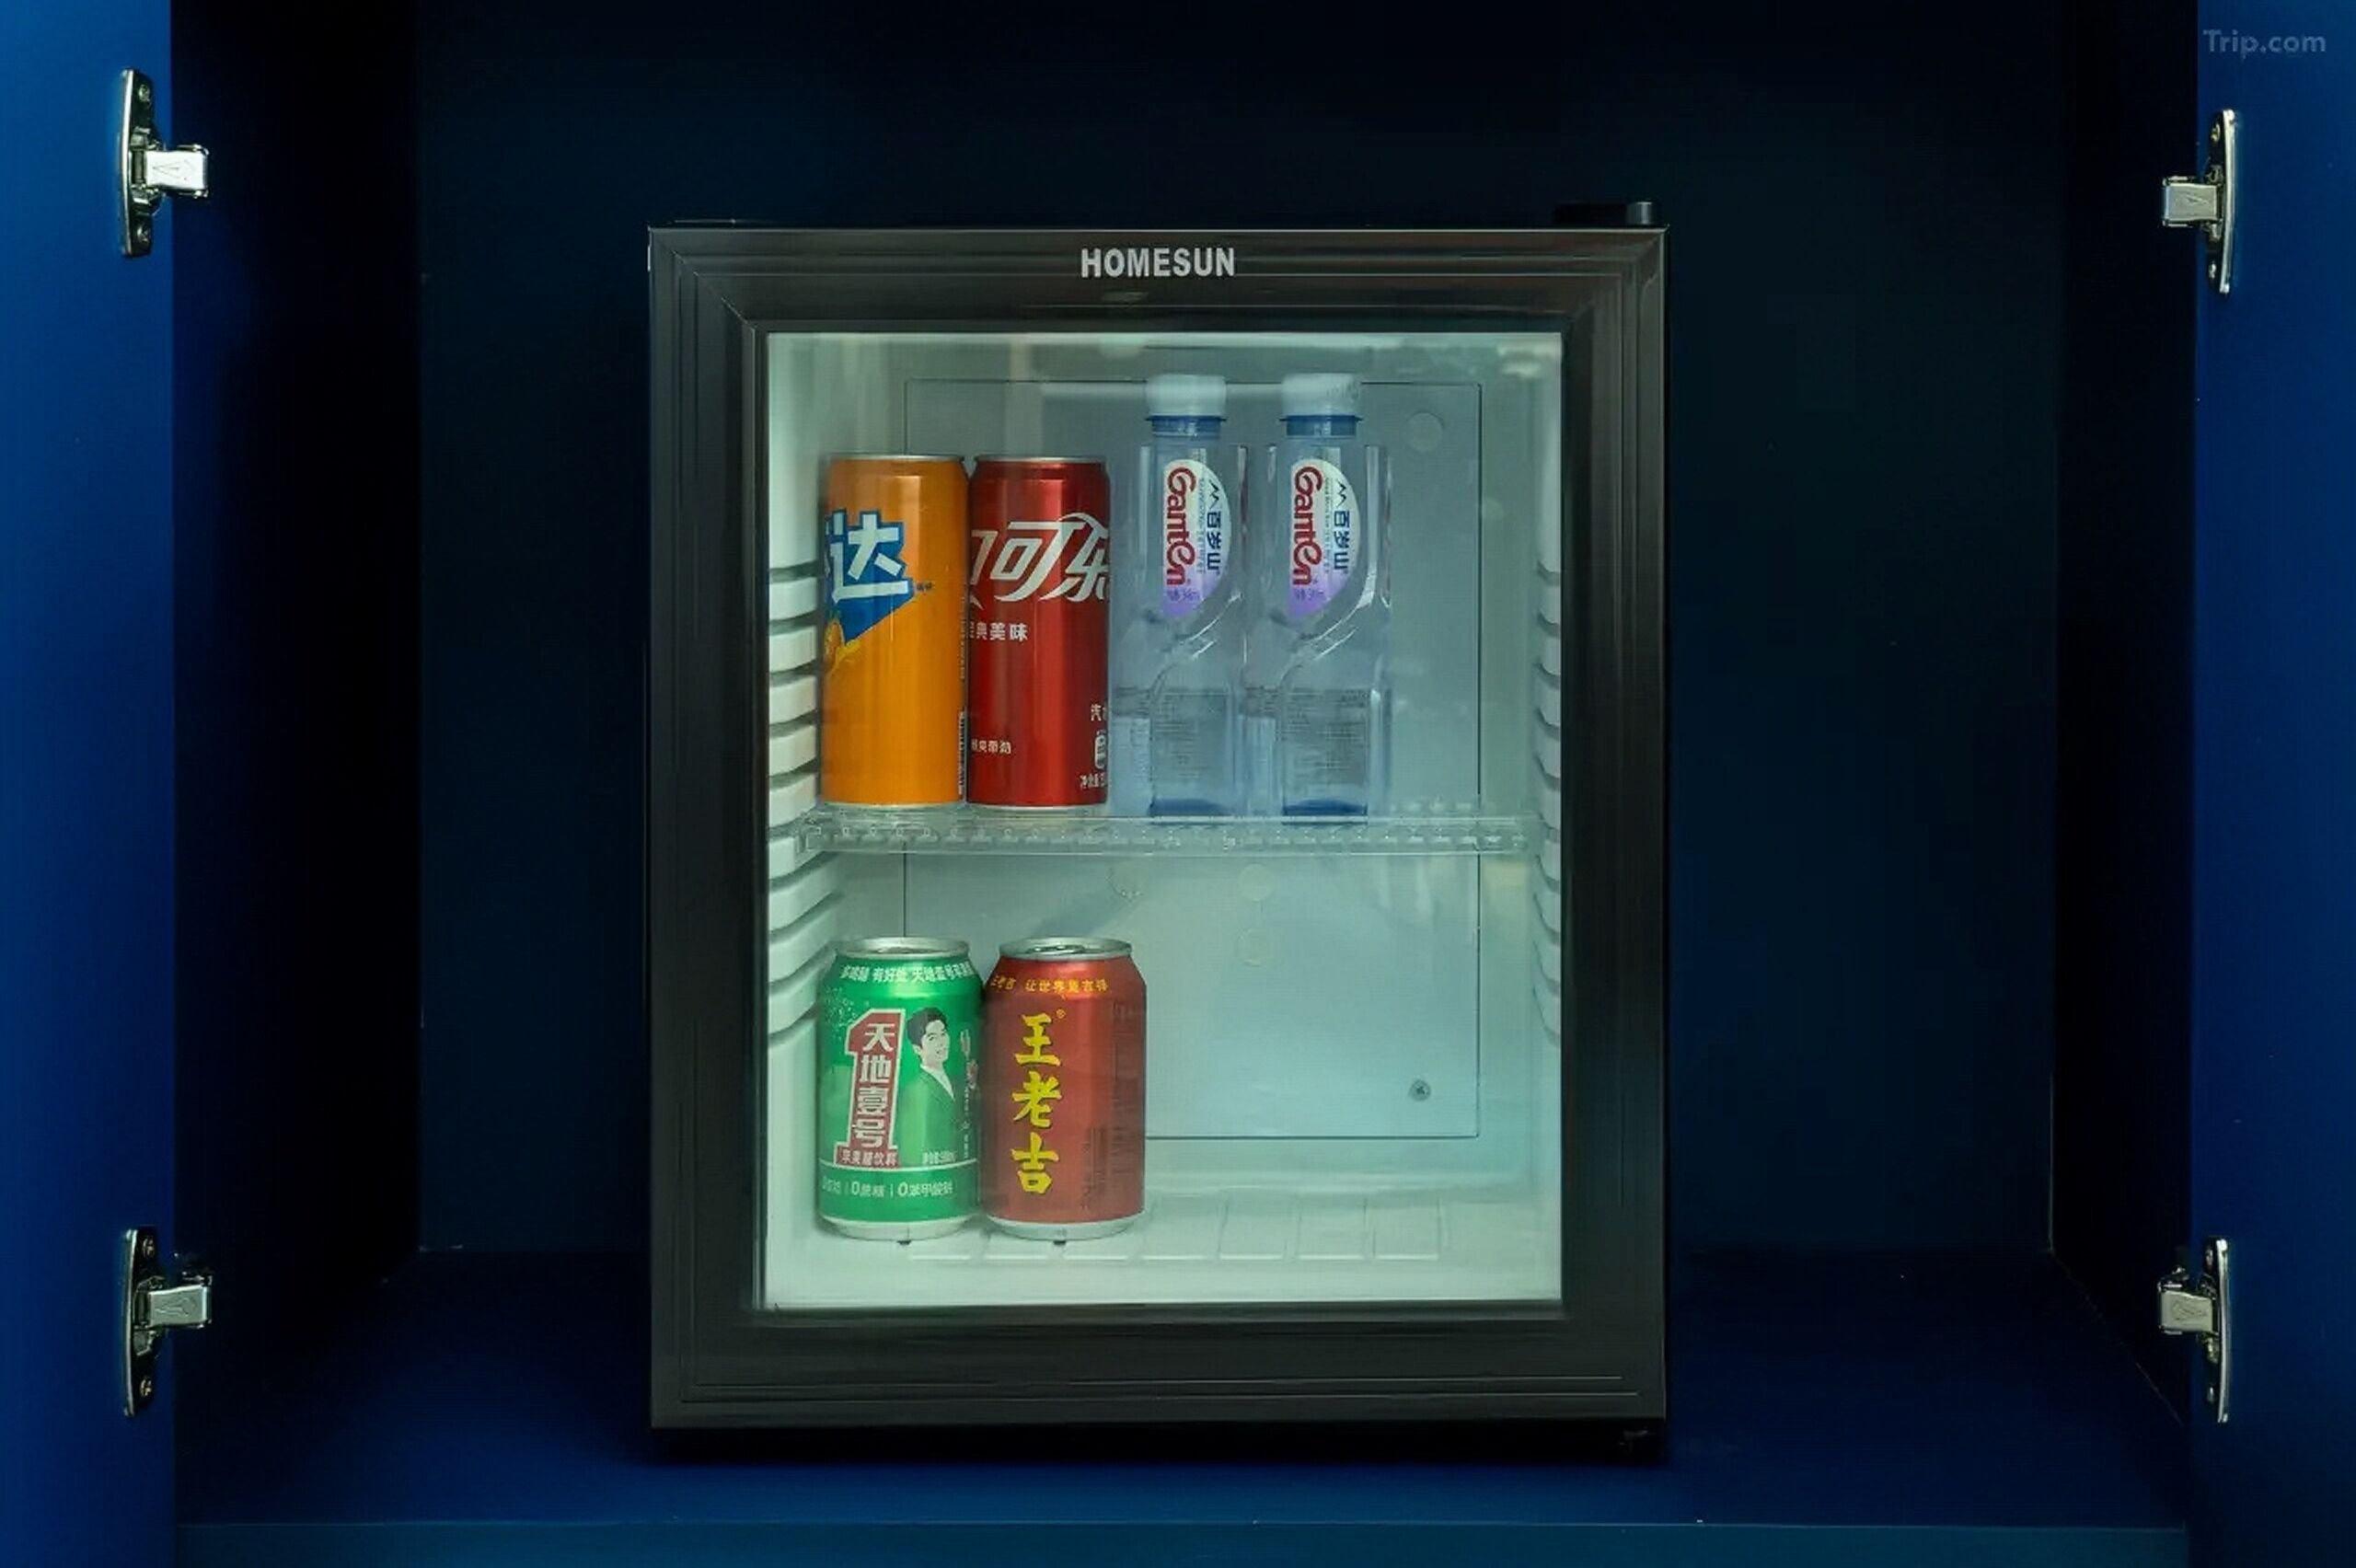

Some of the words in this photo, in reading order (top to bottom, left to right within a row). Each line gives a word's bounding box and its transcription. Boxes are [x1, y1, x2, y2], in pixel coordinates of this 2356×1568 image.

[1080, 248, 1235, 278] HOMESUN
[1207, 512, 1221, 571] 百岁山
[1334, 511, 1350, 571] 百岁山
[851, 1022, 895, 1148] 天地壹号
[1011, 1012, 1062, 1194] 王老吉
